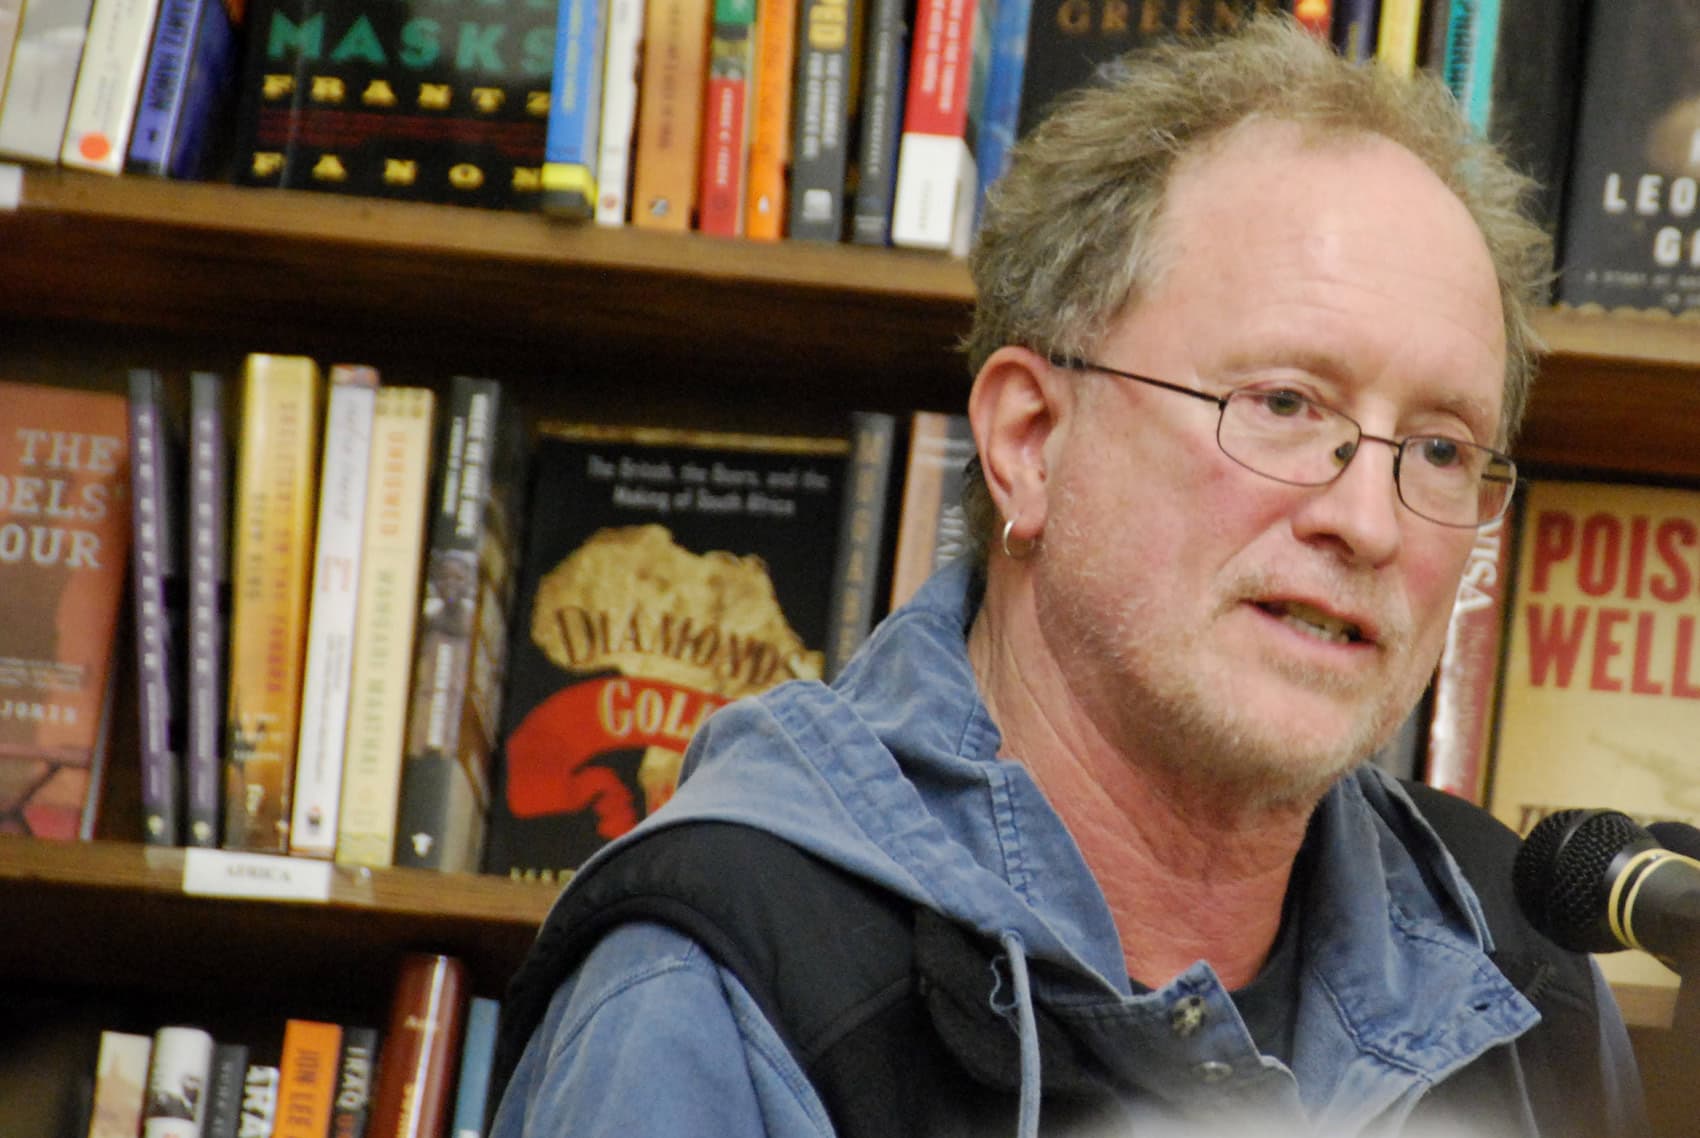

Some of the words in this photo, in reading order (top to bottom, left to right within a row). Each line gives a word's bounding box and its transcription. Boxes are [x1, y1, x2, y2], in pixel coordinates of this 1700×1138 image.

[265, 8, 557, 74] MASKS
[262, 74, 551, 116] FRANTZ
[252, 151, 542, 191] FANON
[15, 427, 121, 474] THE
[337, 1045, 370, 1113] IRAQ
